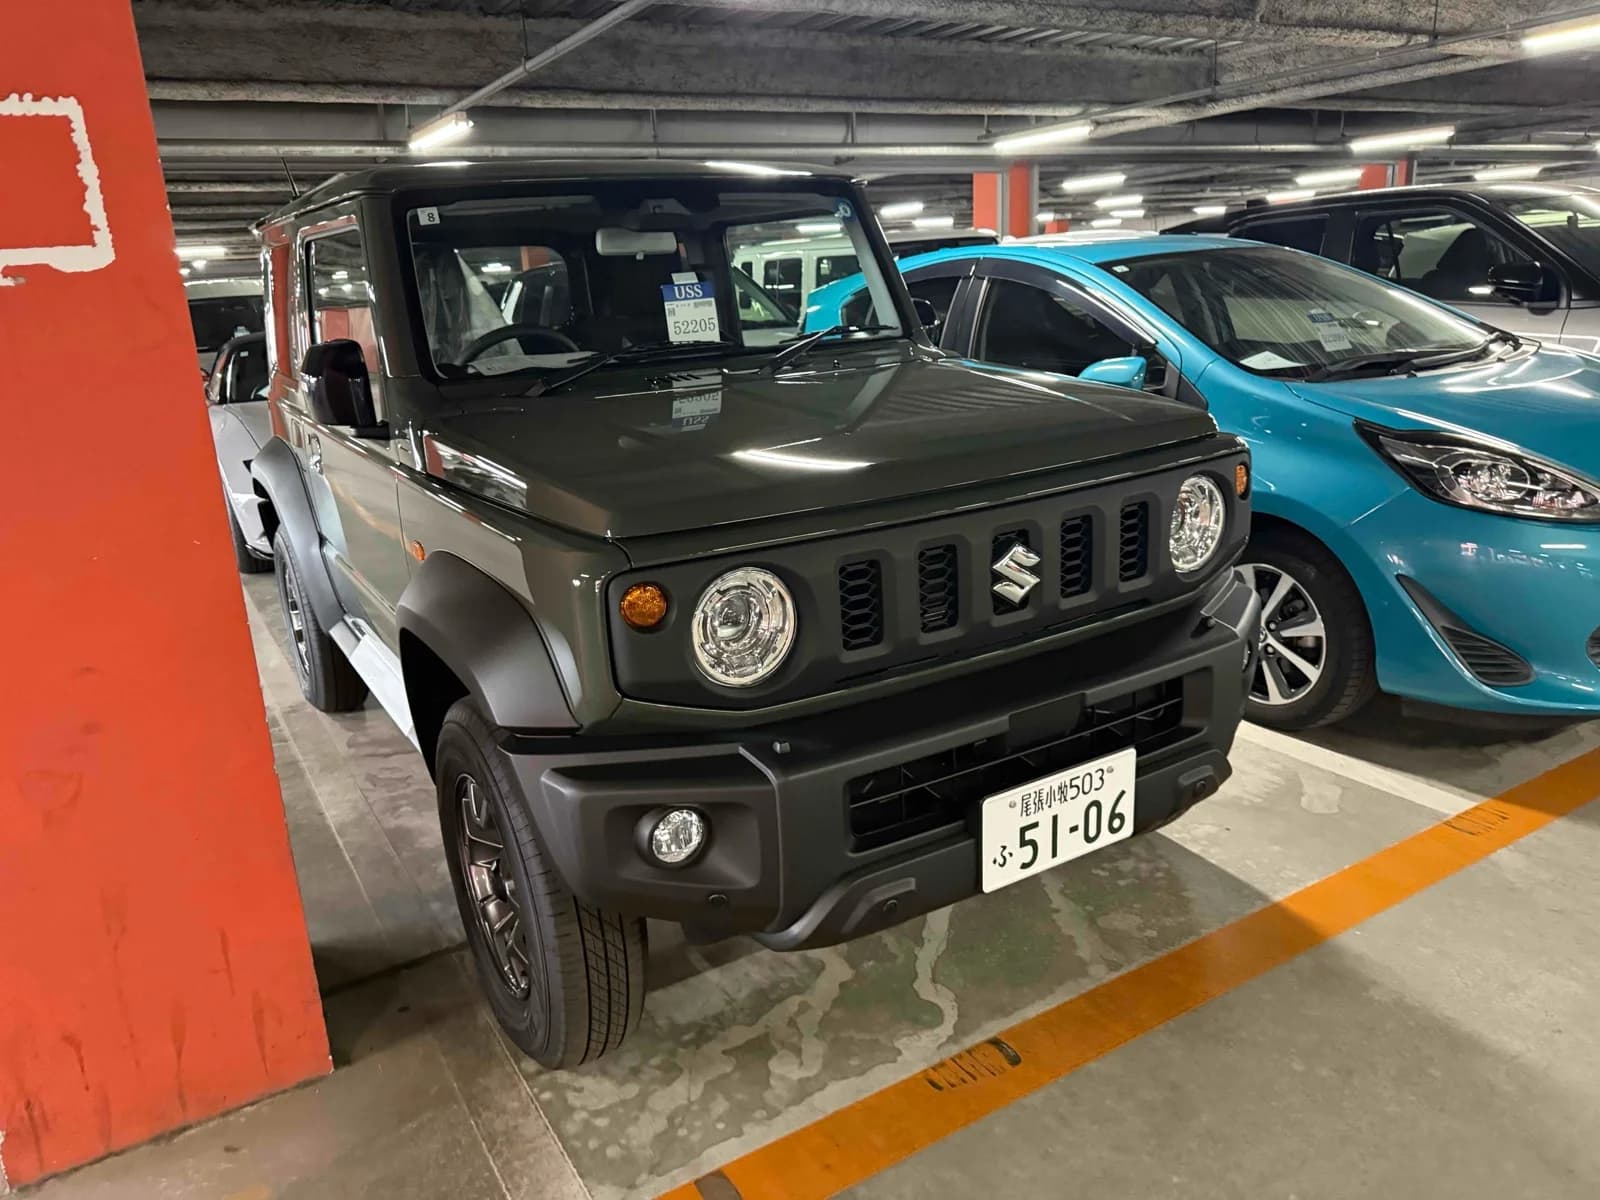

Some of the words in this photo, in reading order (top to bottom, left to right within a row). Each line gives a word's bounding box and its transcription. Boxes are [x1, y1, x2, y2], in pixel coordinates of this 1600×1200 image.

[427, 212, 436, 223] 8
[673, 284, 704, 300] USS
[673, 317, 717, 336] 52205
[992, 845, 1014, 869] ふ
[1019, 789, 1126, 870] 51-06
